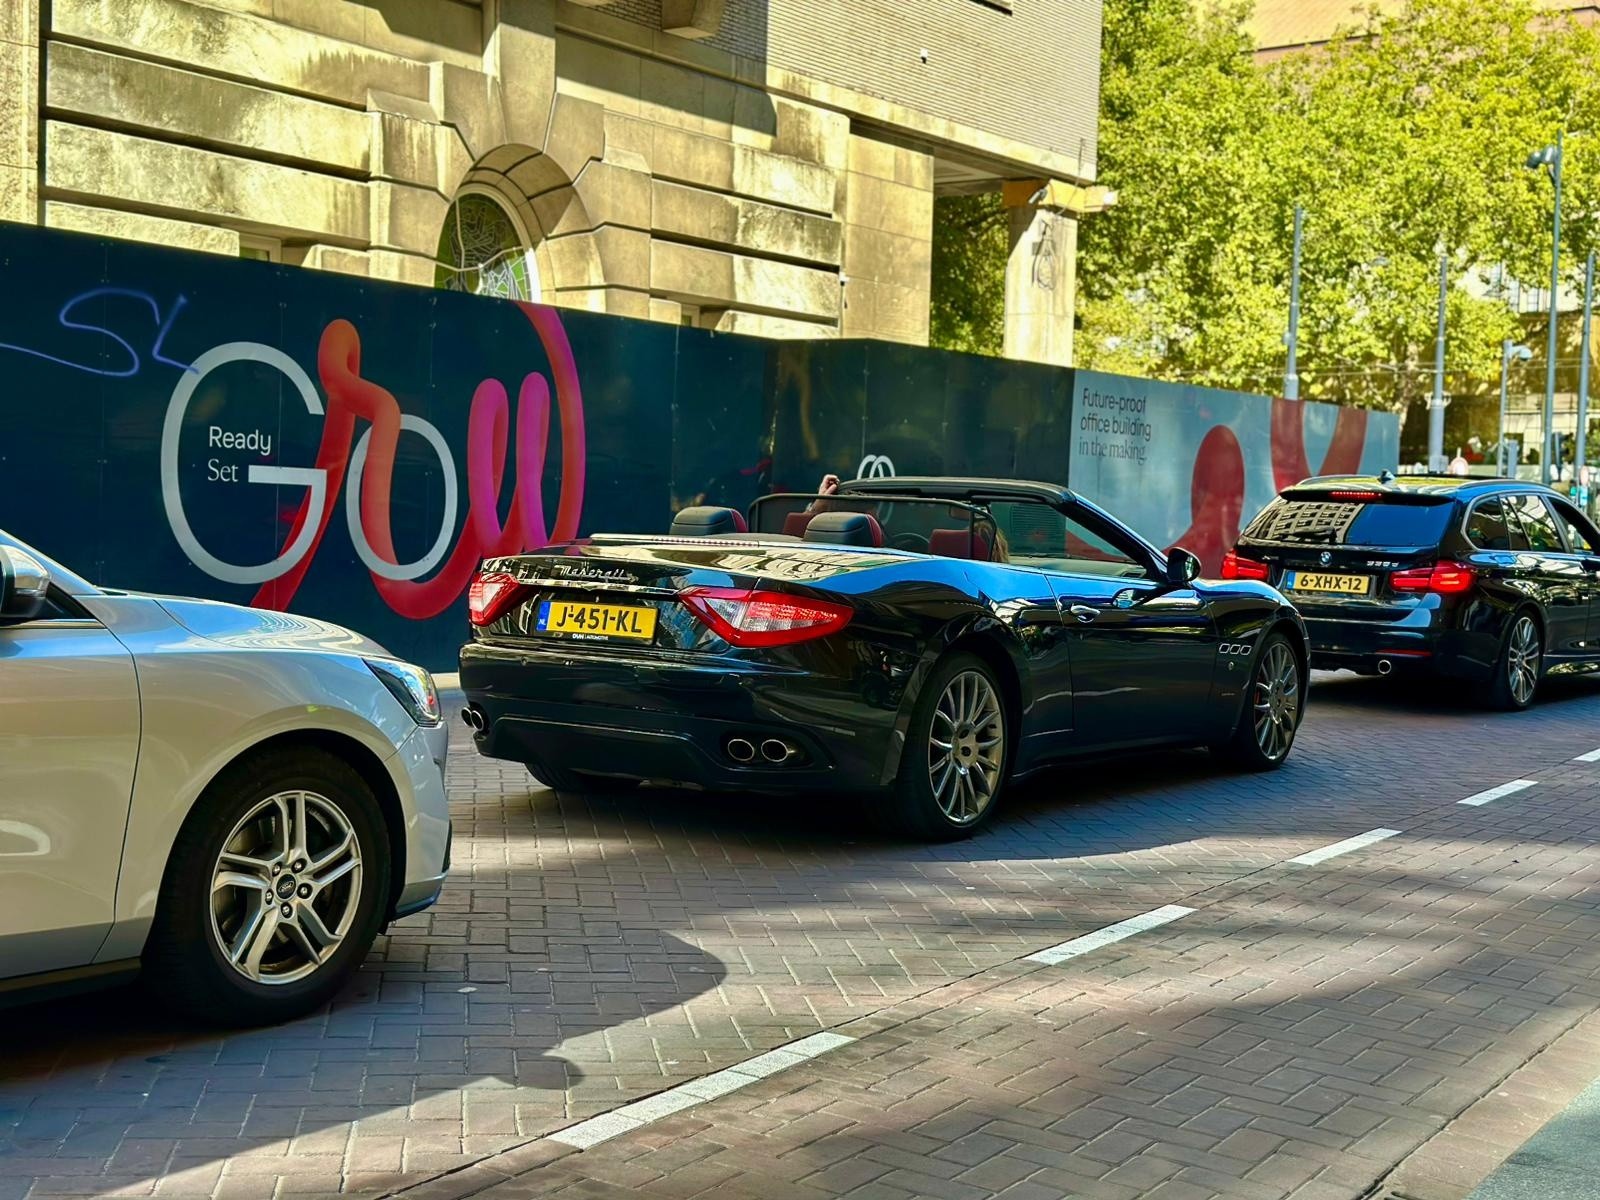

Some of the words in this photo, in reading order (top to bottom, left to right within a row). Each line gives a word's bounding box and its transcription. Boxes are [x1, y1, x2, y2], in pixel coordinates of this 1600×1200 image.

[1083, 388, 1146, 414] Future-proof
[1080, 412, 1110, 432] office
[1112, 417, 1151, 442] building
[209, 426, 272, 456] Ready
[1079, 437, 1088, 456] in
[1090, 436, 1107, 457] the
[207, 458, 239, 482] Set
[1300, 574, 1362, 591] 6-XHX-12
